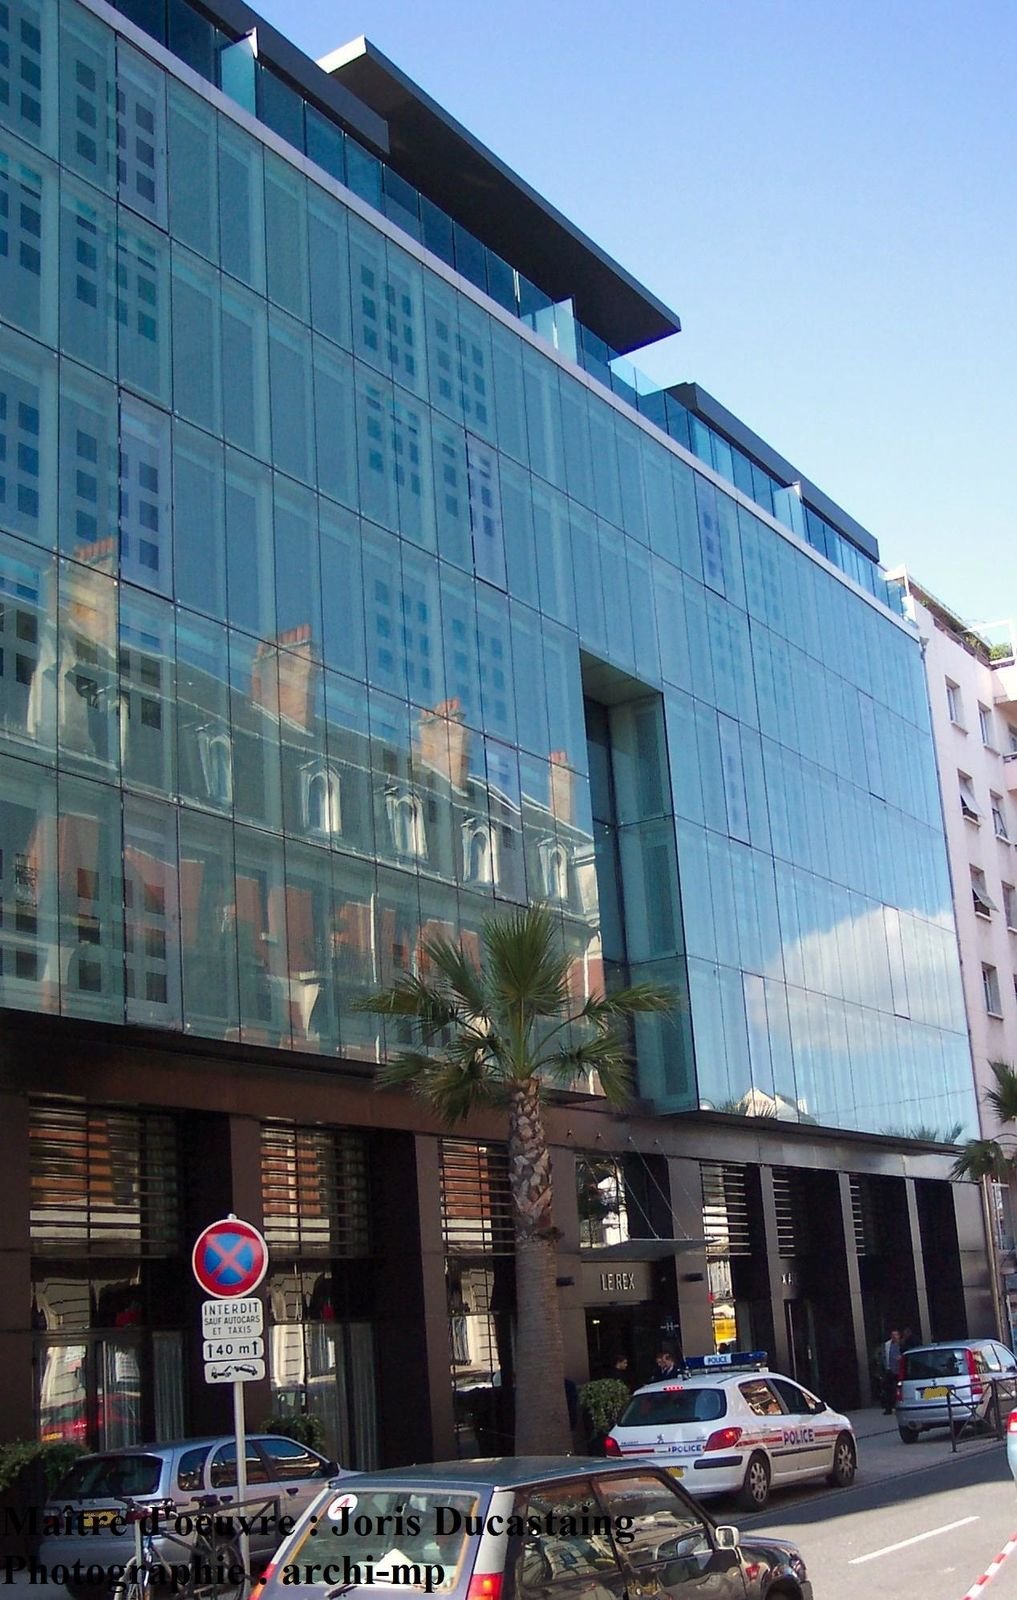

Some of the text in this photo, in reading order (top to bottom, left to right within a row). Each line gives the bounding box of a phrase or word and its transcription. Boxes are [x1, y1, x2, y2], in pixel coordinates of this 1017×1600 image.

[601, 1273, 635, 1291] LE REX
[204, 1302, 259, 1315] INTERDIT
[204, 1315, 260, 1326] SAUF AUTOCARS
[212, 1325, 252, 1336] ET TAXIS
[216, 1344, 250, 1355] 40 m
[706, 1356, 729, 1364] POLICE
[783, 1428, 815, 1446] POLICE
[671, 1444, 702, 1453] POLICE
